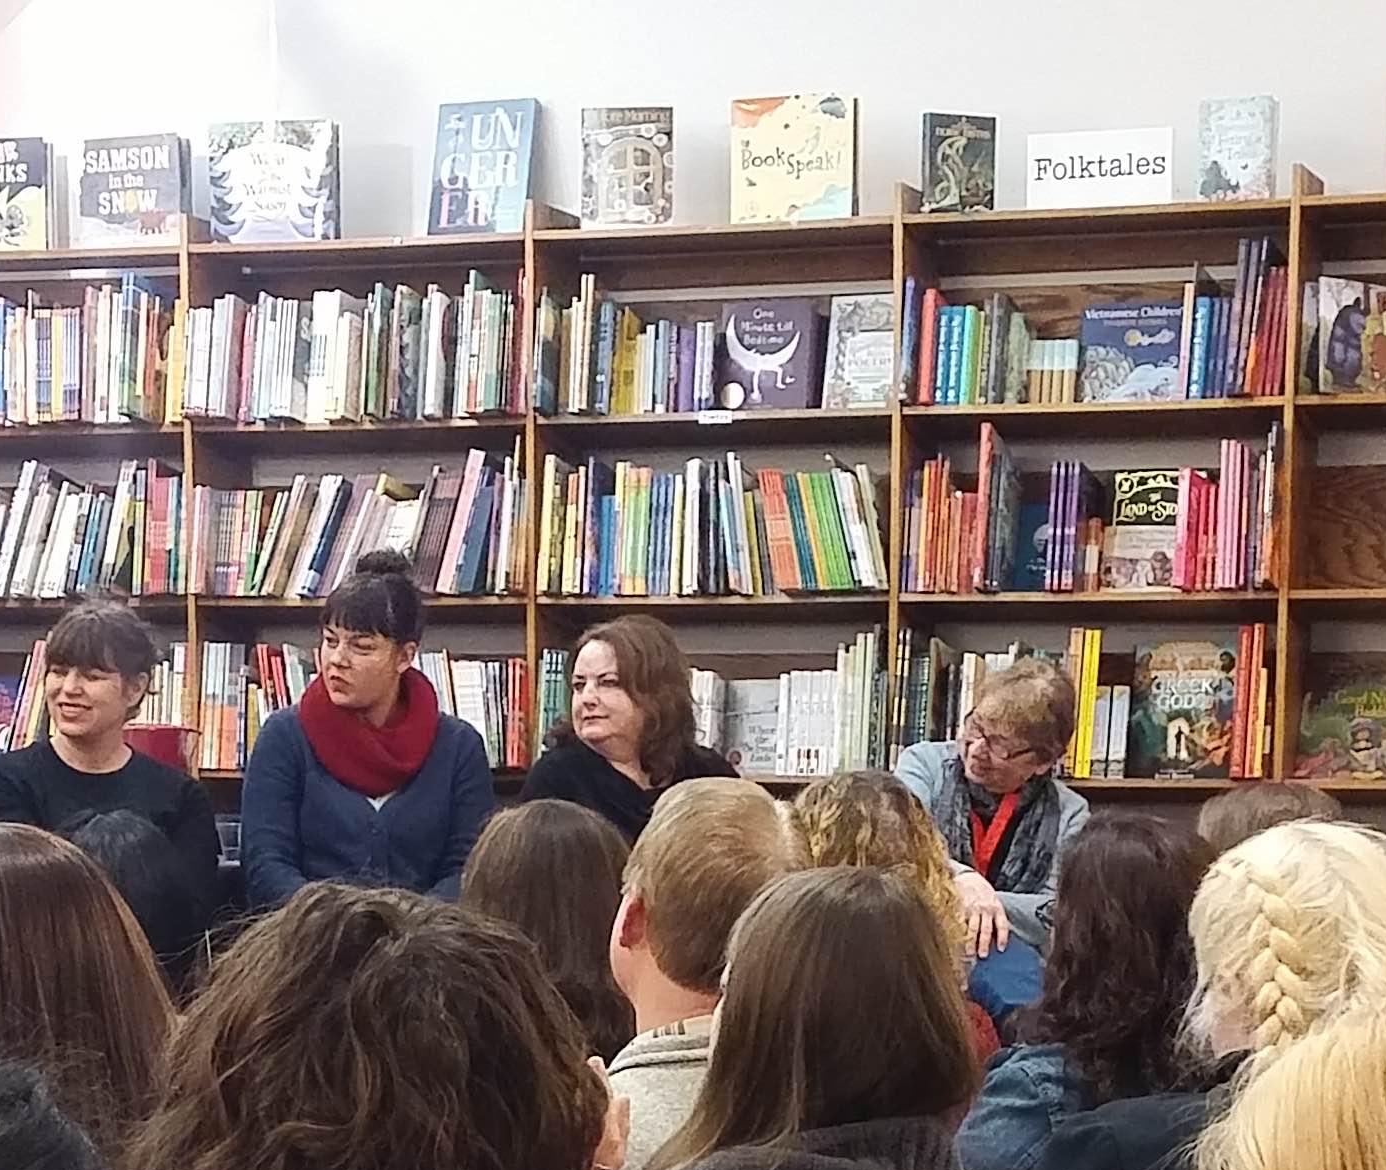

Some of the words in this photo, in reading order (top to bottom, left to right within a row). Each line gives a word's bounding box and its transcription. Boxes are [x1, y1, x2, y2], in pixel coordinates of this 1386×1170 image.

[85, 145, 170, 173] SAMSON
[1034, 153, 1166, 181] Folktales
[123, 173, 144, 188] the
[98, 189, 158, 215] SNOW
[753, 307, 774, 319] One
[1140, 306, 1184, 318] Children'
